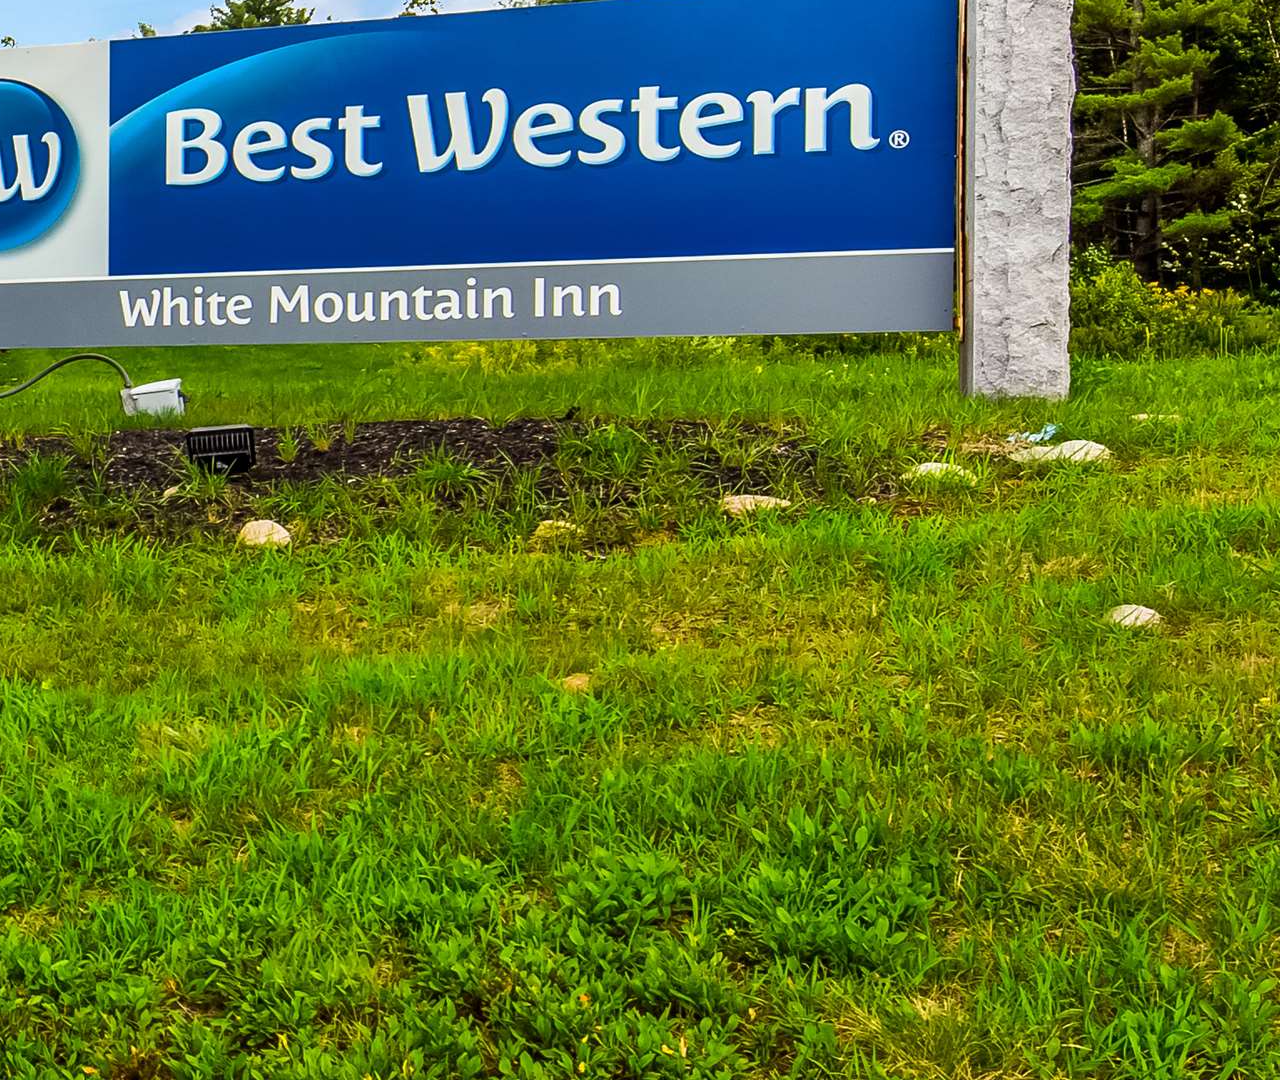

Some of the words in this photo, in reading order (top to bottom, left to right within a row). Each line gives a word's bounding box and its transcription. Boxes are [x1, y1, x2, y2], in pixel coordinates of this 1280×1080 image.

[165, 104, 384, 187] Best
[118, 285, 254, 327] White
[268, 276, 516, 324] Mountain
[533, 276, 624, 318] Inn
